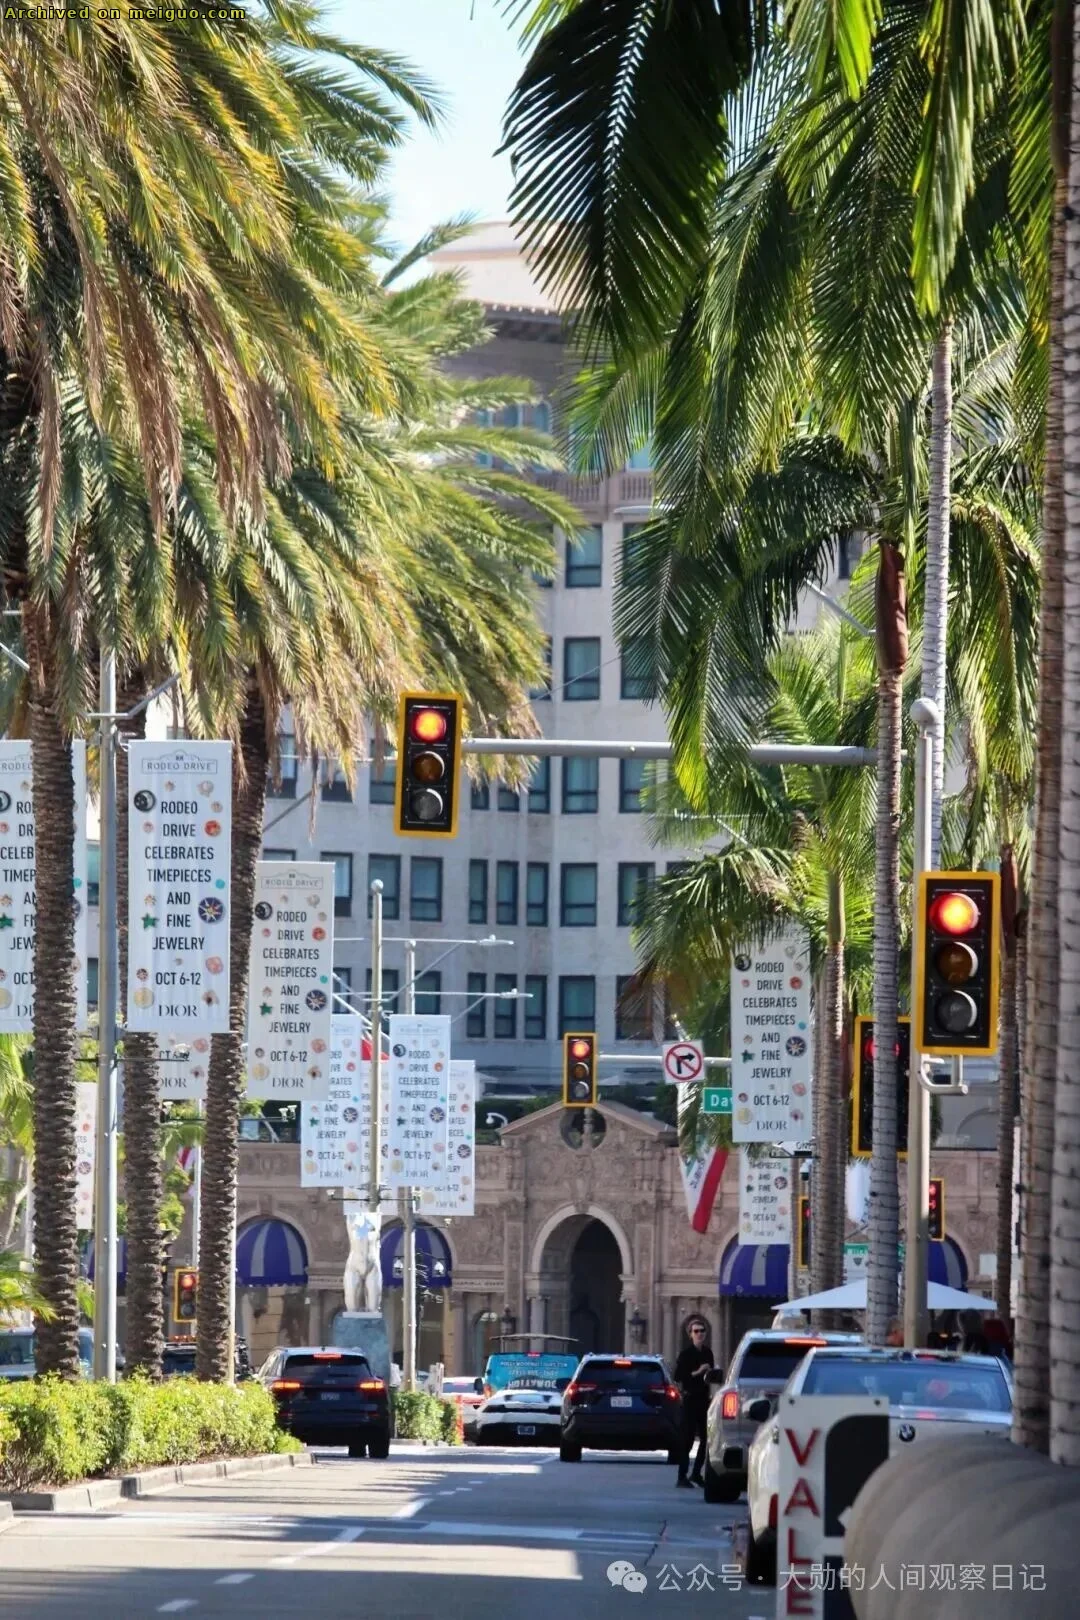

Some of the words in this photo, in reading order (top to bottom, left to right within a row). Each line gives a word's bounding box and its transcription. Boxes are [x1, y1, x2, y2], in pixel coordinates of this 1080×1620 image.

[147, 762, 180, 771] RODEO
[183, 762, 212, 771] DRIVE
[161, 801, 198, 814] RODEO
[162, 824, 196, 837] DRIVE
[0, 846, 34, 860] CELEB
[144, 846, 214, 860] CELEBRATES
[4, 869, 37, 883] TIMEP
[147, 869, 212, 883] TIMEPIECES
[167, 892, 191, 905] AND
[166, 914, 191, 928] FINE
[277, 911, 307, 922] RODEO
[278, 930, 305, 941] DRIVE
[152, 937, 205, 950] JEWELRY
[263, 948, 319, 960] CELEBRATES
[265, 966, 317, 978] TIMEPIECES
[755, 962, 784, 973] RODEO
[155, 972, 177, 986] OCT
[179, 972, 201, 986] 6-12
[281, 985, 300, 996] AND
[757, 980, 783, 990] DRIVE
[743, 997, 797, 1008] CELEBRATES
[158, 1005, 198, 1017] DIOR
[280, 1004, 299, 1015] FINE
[746, 1015, 796, 1025] TIMEPIECES
[269, 1022, 311, 1033] JEWELRY
[762, 1032, 780, 1043] AND
[270, 1051, 287, 1062] OCT
[289, 1051, 308, 1062] 6-12
[408, 1051, 431, 1059] RODEO
[761, 1050, 781, 1061] FINE
[409, 1064, 429, 1072] DRIVE
[751, 1068, 792, 1078] JEWELRY
[272, 1078, 304, 1088] DIOR
[398, 1077, 440, 1086] CELEBRATES
[400, 1090, 438, 1099] TIMEPIECES
[711, 1094, 732, 1107] Da
[754, 1095, 770, 1106] OCT
[773, 1095, 790, 1106] 6-12
[325, 1104, 339, 1112] AND
[412, 1104, 426, 1112] AND
[325, 1117, 339, 1126] FINE
[411, 1117, 425, 1125] FINE
[757, 1121, 788, 1131] DIOR
[317, 1130, 346, 1139] JEWELRY
[403, 1130, 433, 1138] JEWELRY
